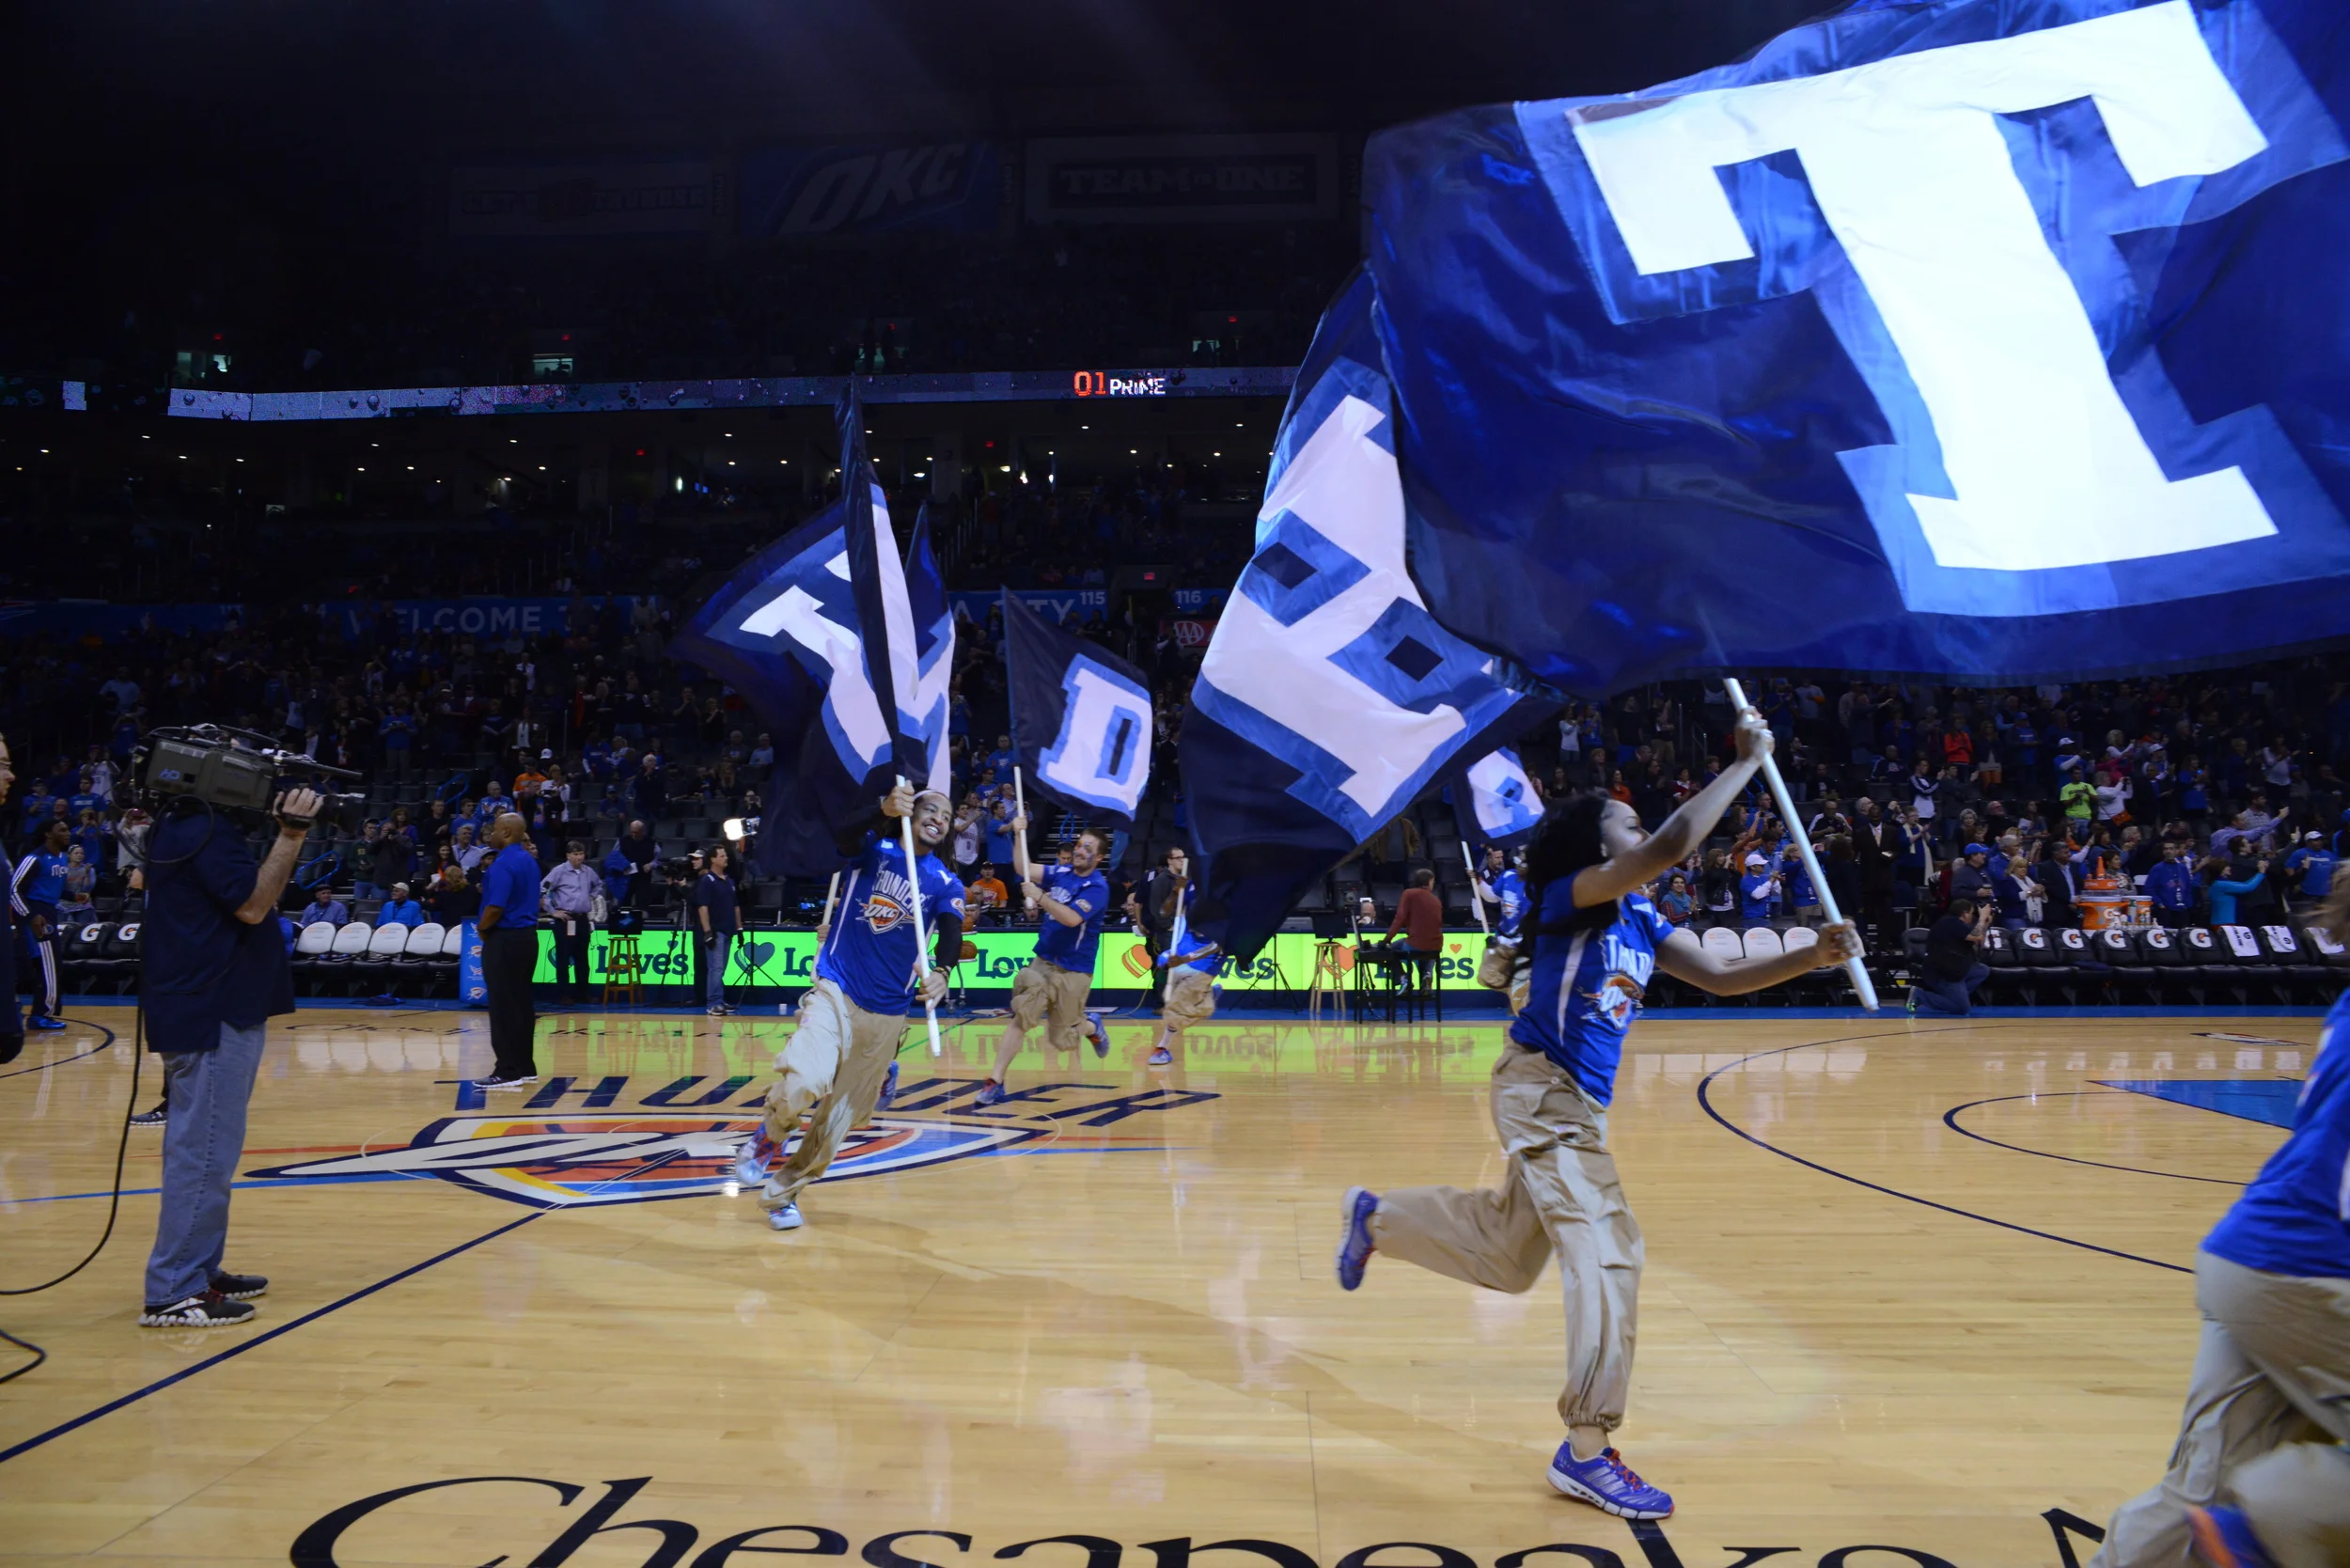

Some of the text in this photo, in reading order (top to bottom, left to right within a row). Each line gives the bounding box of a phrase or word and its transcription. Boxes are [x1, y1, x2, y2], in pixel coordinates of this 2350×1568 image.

[778, 143, 966, 233] OKC
[1568, 0, 2278, 570] T
[1079, 591, 1105, 605] 115
[1175, 590, 1202, 604] 116
[872, 870, 927, 914] HUNDER
[864, 903, 899, 918] OKC
[2023, 929, 2044, 949] G
[2062, 929, 2084, 949] G
[2105, 929, 2126, 949] G
[2147, 929, 2170, 949] G
[2189, 929, 2212, 948] G
[434, 1074, 1222, 1127] THUDER
